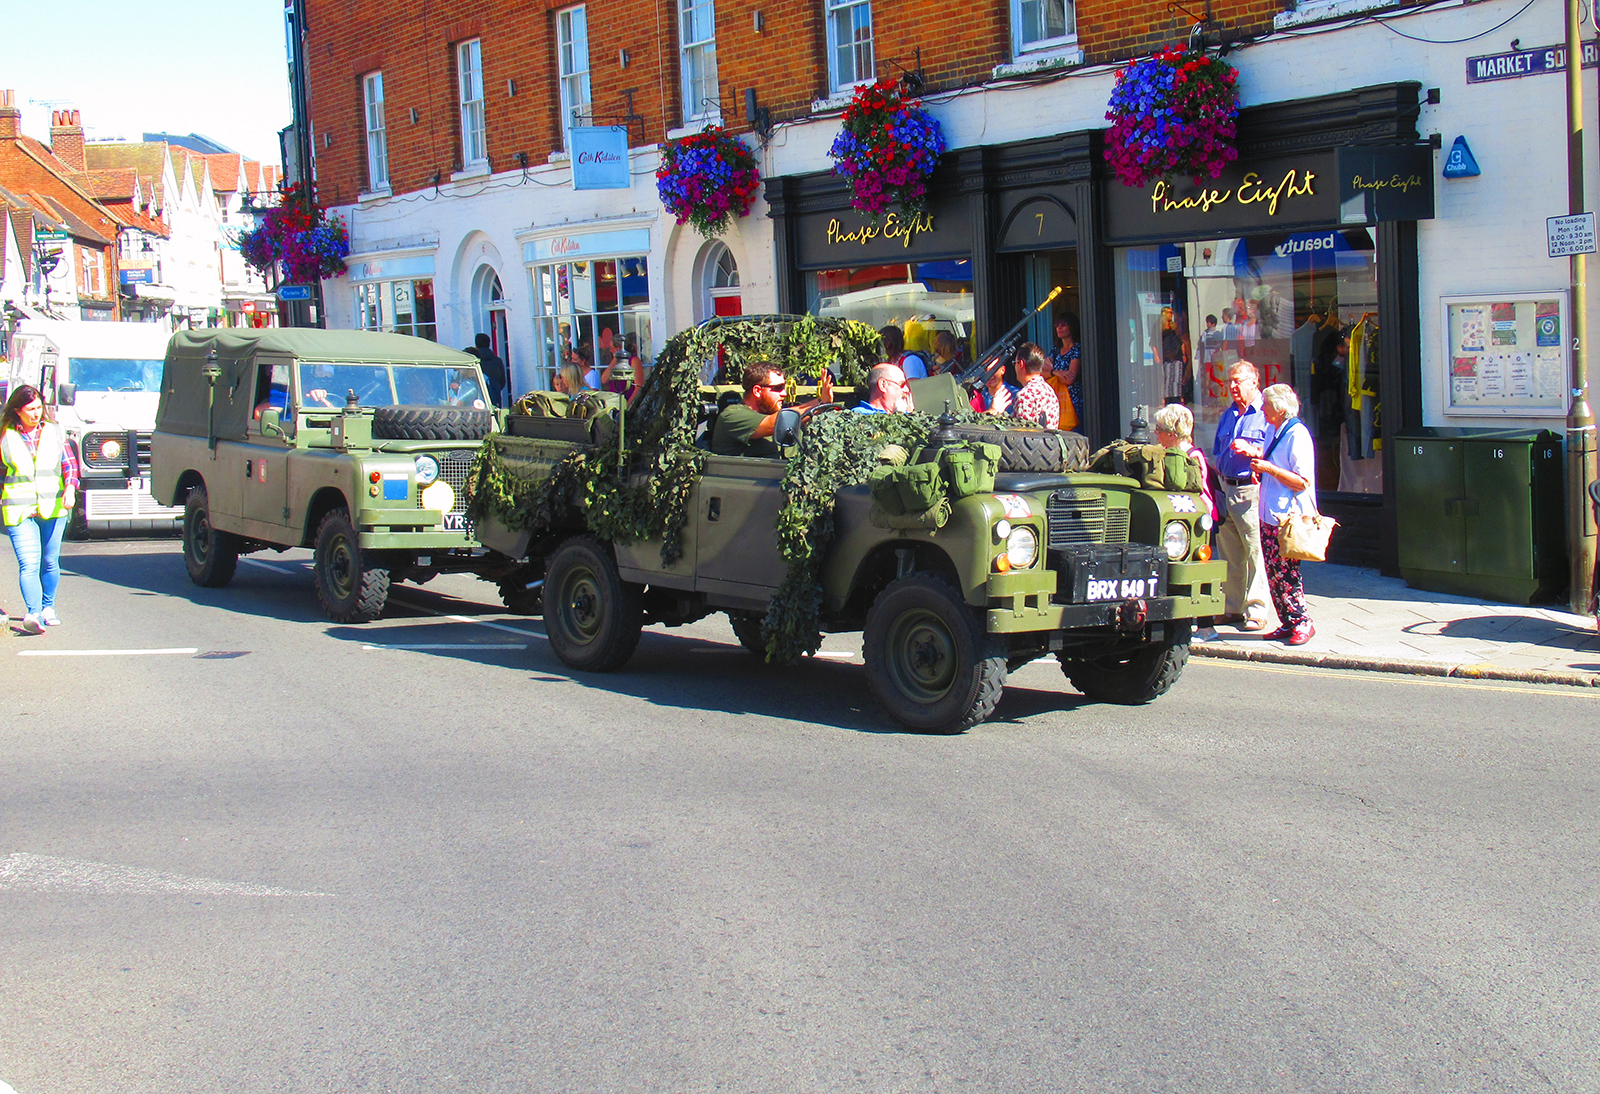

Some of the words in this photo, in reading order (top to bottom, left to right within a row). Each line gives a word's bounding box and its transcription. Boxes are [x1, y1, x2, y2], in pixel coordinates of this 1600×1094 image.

[1477, 53, 1533, 78] MARKET
[1545, 44, 1599, 69] SQR
[578, 151, 593, 164] Cath
[594, 150, 621, 164] Kidston
[1446, 163, 1467, 171] Chubb
[1352, 175, 1388, 190] Phase
[1390, 174, 1422, 192] Eight
[1150, 180, 1232, 213] Phase
[1237, 169, 1315, 216] Eight
[826, 218, 880, 245] Phase
[883, 211, 935, 248] Eight
[1034, 213, 1044, 236] 7
[560, 237, 580, 254] Kidston
[1572, 337, 1580, 350] 2
[1413, 446, 1423, 455] 16
[1493, 449, 1504, 458] 16
[1543, 449, 1553, 458] 16
[1087, 579, 1119, 600] BRX
[1147, 578, 1159, 599] T
